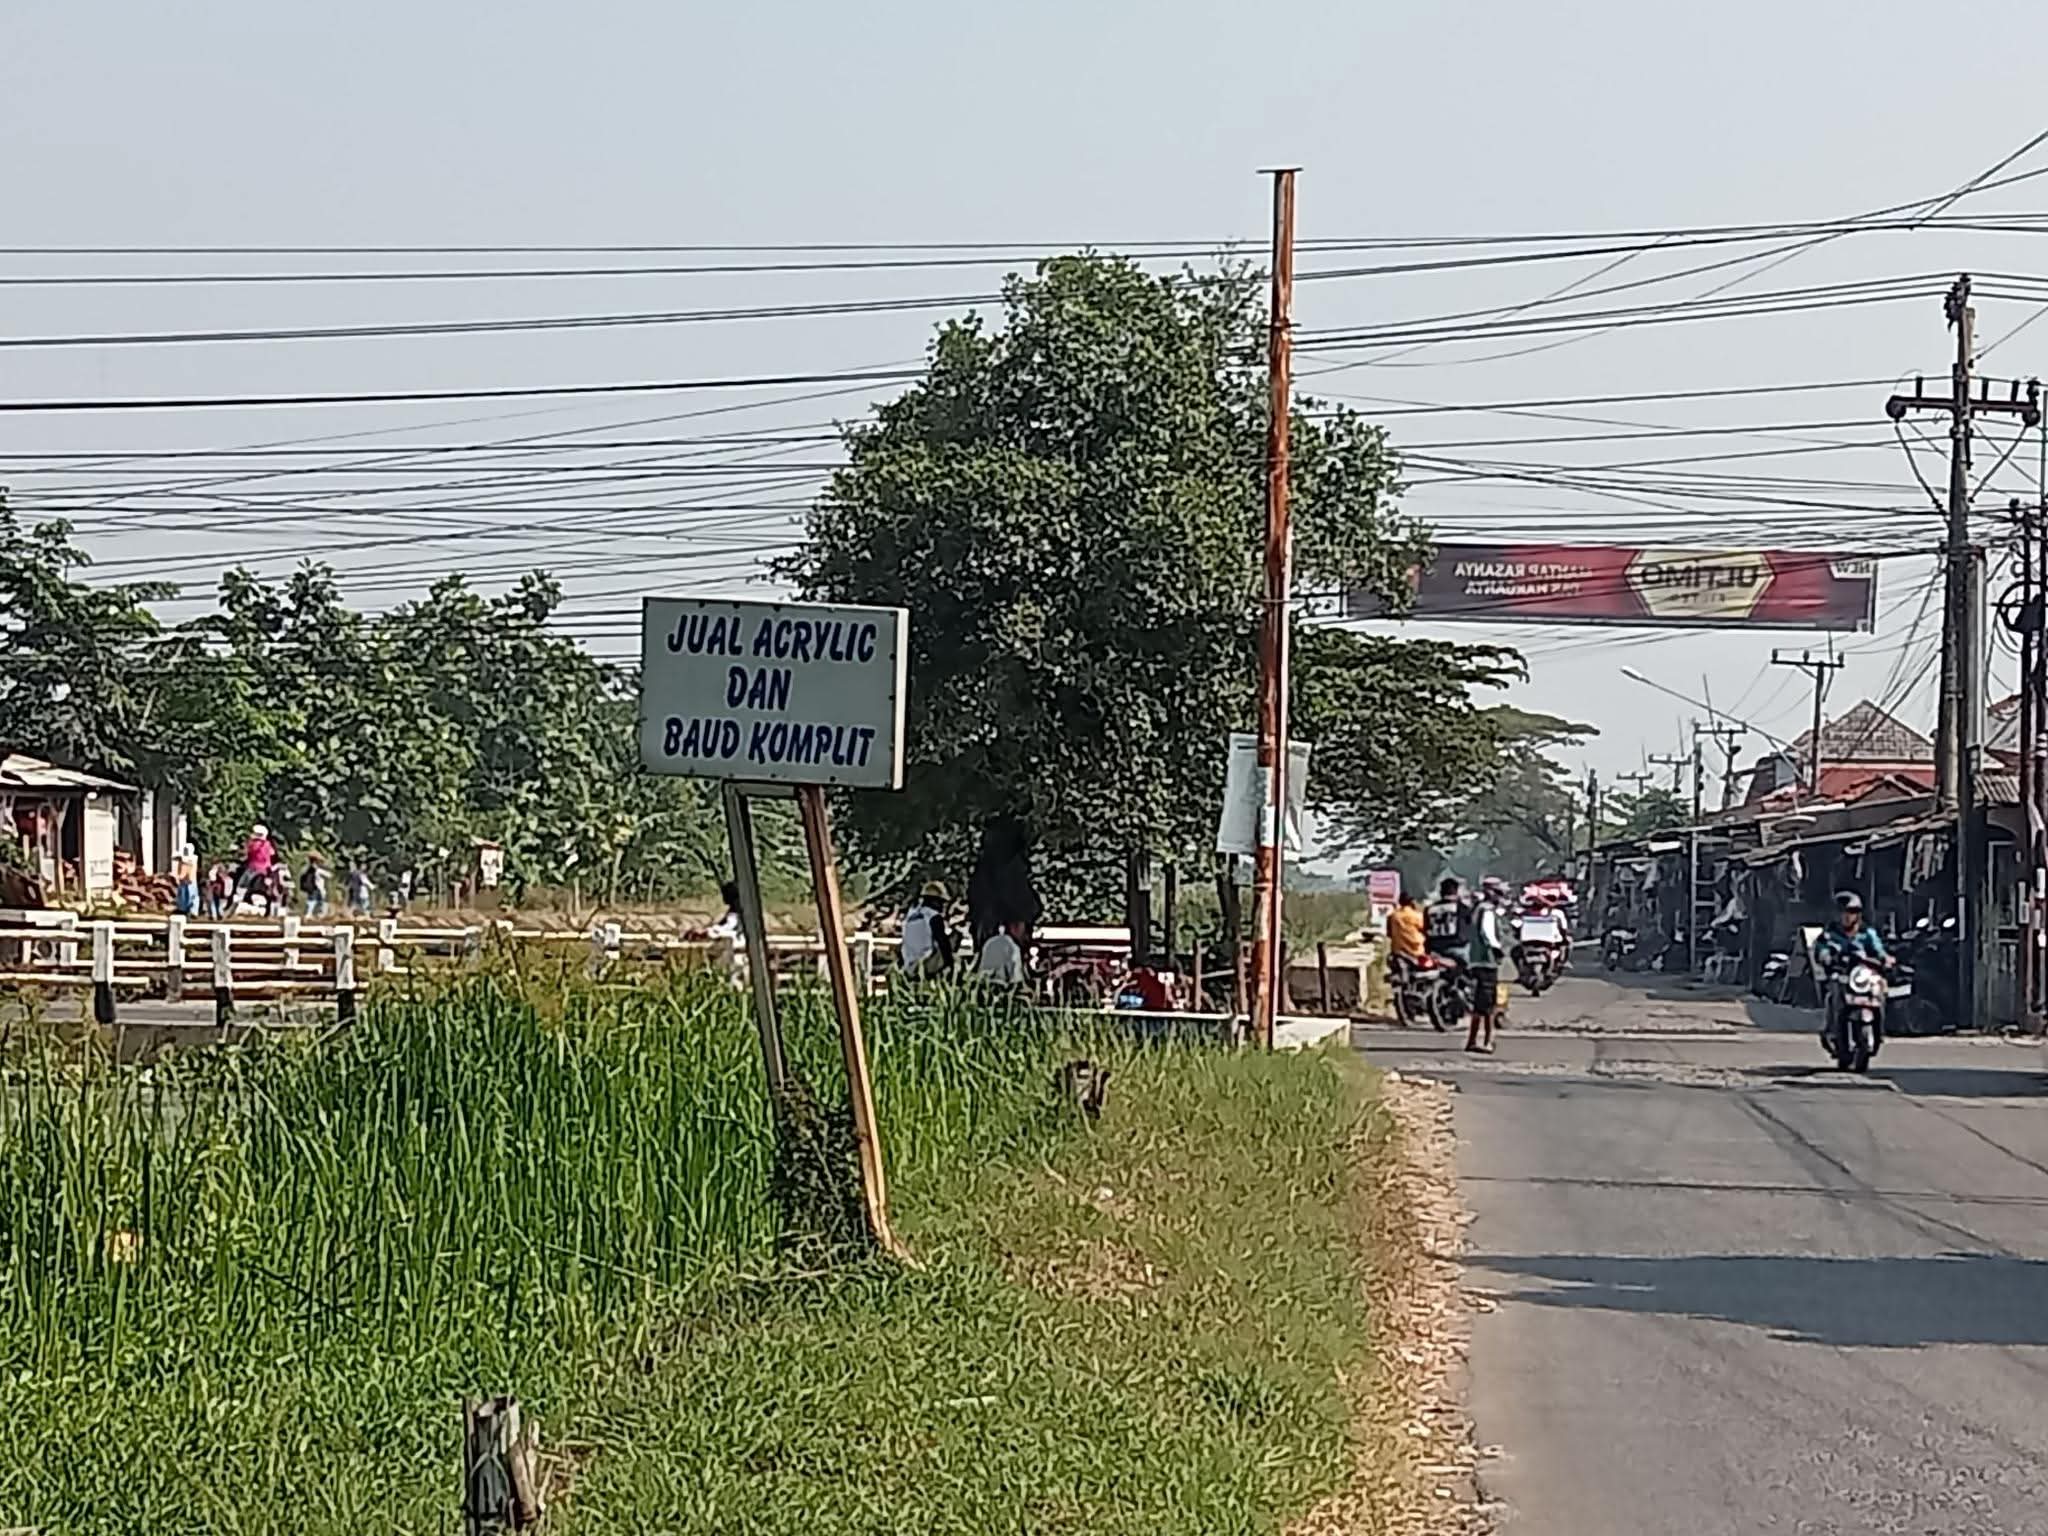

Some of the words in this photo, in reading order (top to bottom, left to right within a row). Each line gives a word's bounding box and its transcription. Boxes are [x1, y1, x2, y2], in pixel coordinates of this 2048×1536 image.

[668, 615, 743, 655] JUAL
[752, 618, 877, 662] ACRYLIC
[727, 666, 792, 710] DAN
[664, 717, 741, 759] BAUD
[748, 721, 876, 766] KOMPLIT
